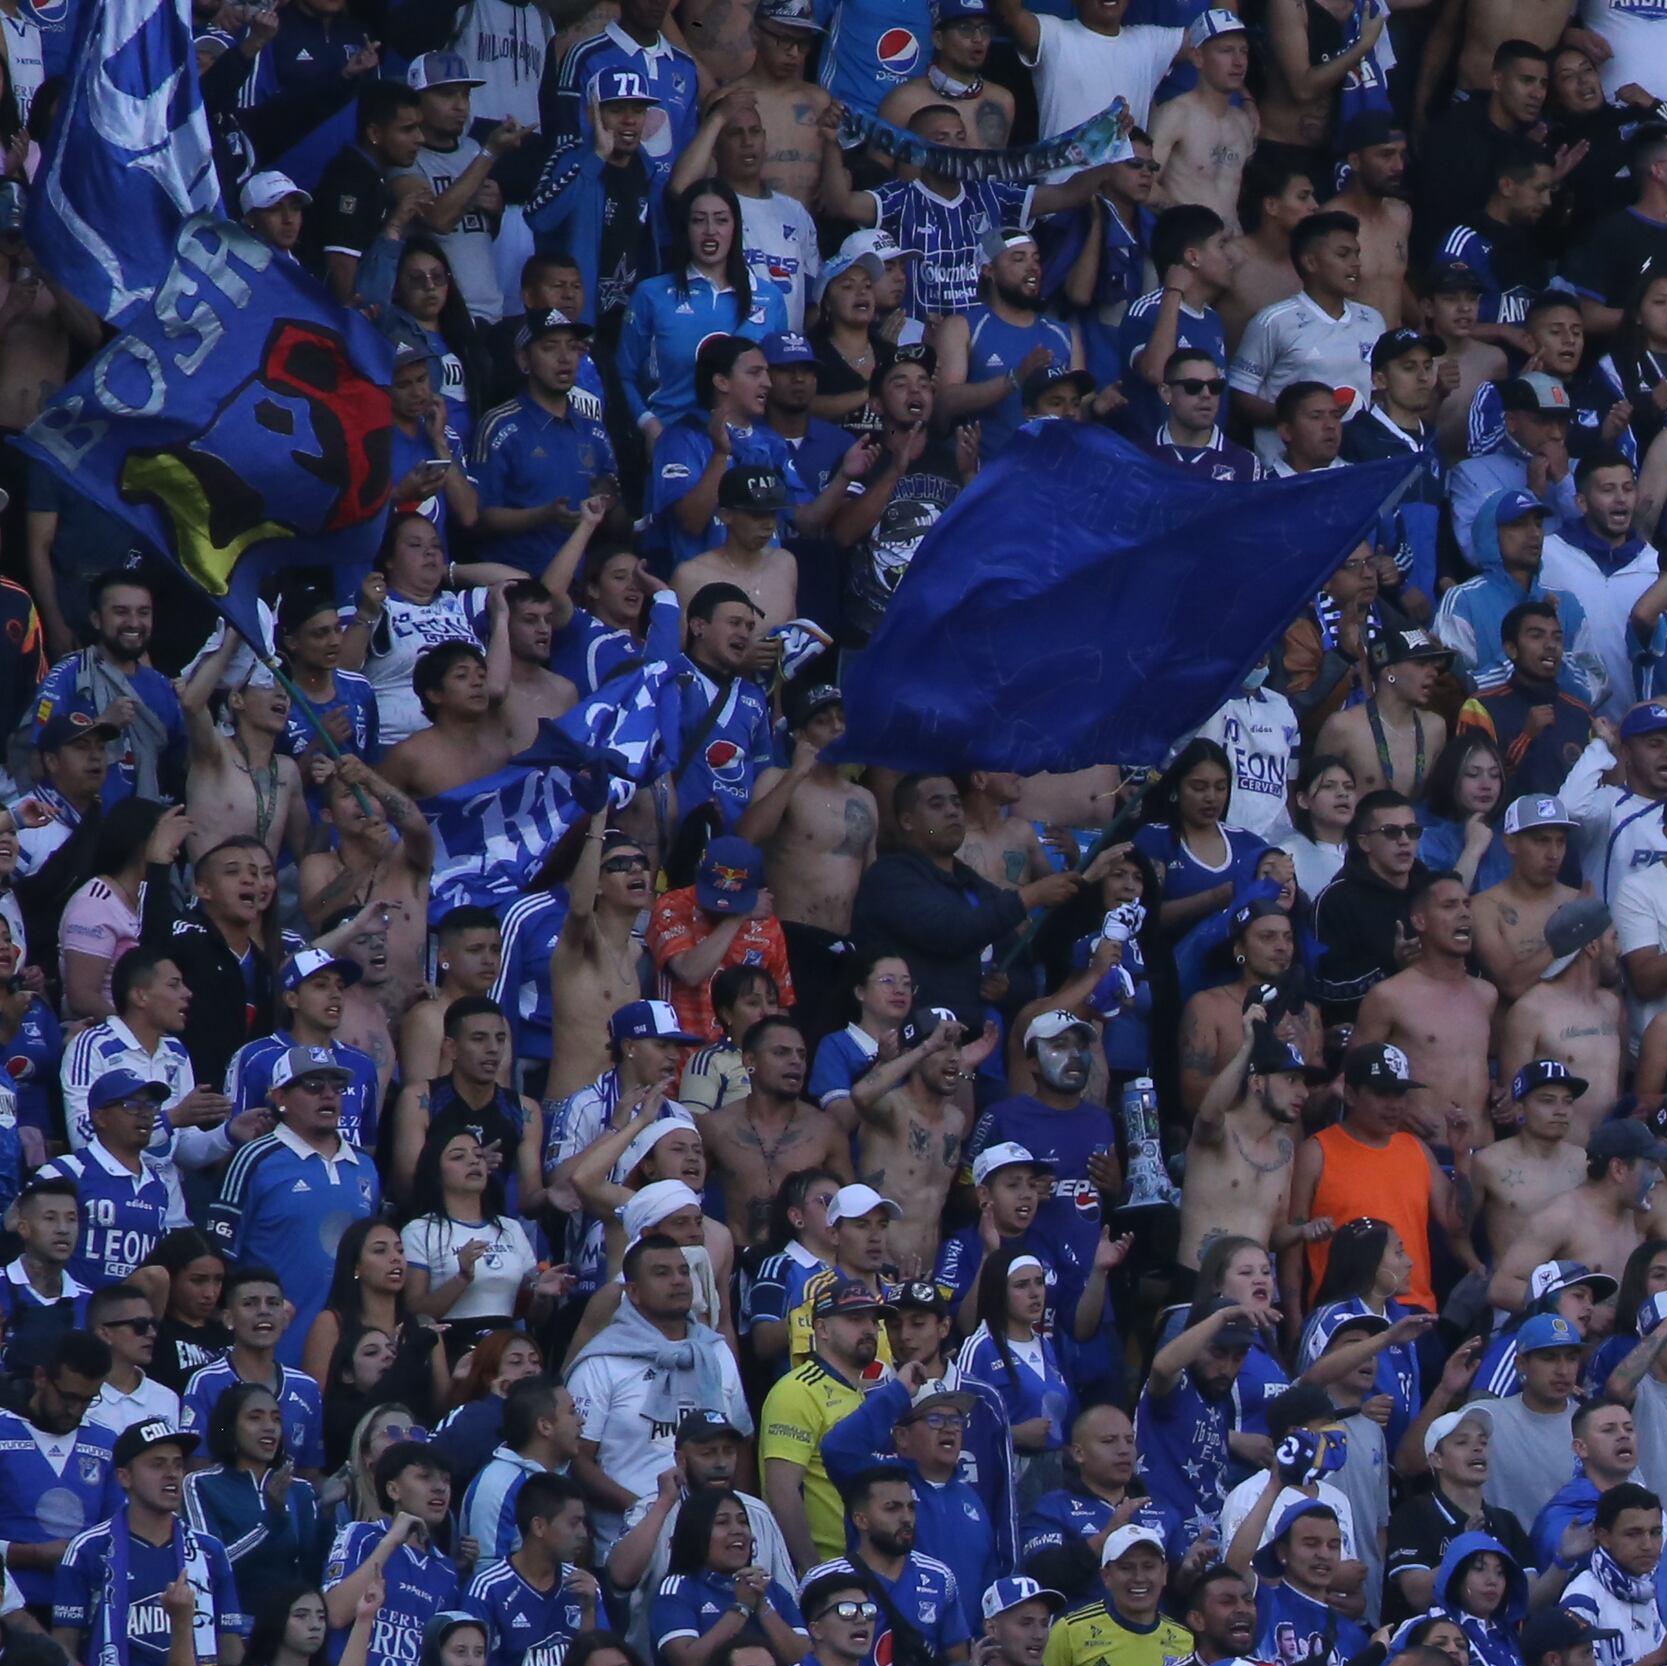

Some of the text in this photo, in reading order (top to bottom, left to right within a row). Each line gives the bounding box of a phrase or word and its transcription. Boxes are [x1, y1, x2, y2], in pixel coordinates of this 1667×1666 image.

[613, 73, 641, 97] 77
[942, 285, 979, 301] nuestr
[24, 212, 274, 472] BOSA
[1236, 748, 1286, 783] EON
[1539, 1062, 1565, 1078] 77
[84, 1200, 116, 1227] 10
[125, 1199, 153, 1211] adidas
[84, 1228, 157, 1264] LEON
[0, 1440, 34, 1451] YUNDAI
[76, 1445, 112, 1459] HYUNDAI
[128, 1603, 171, 1635] ANDI
